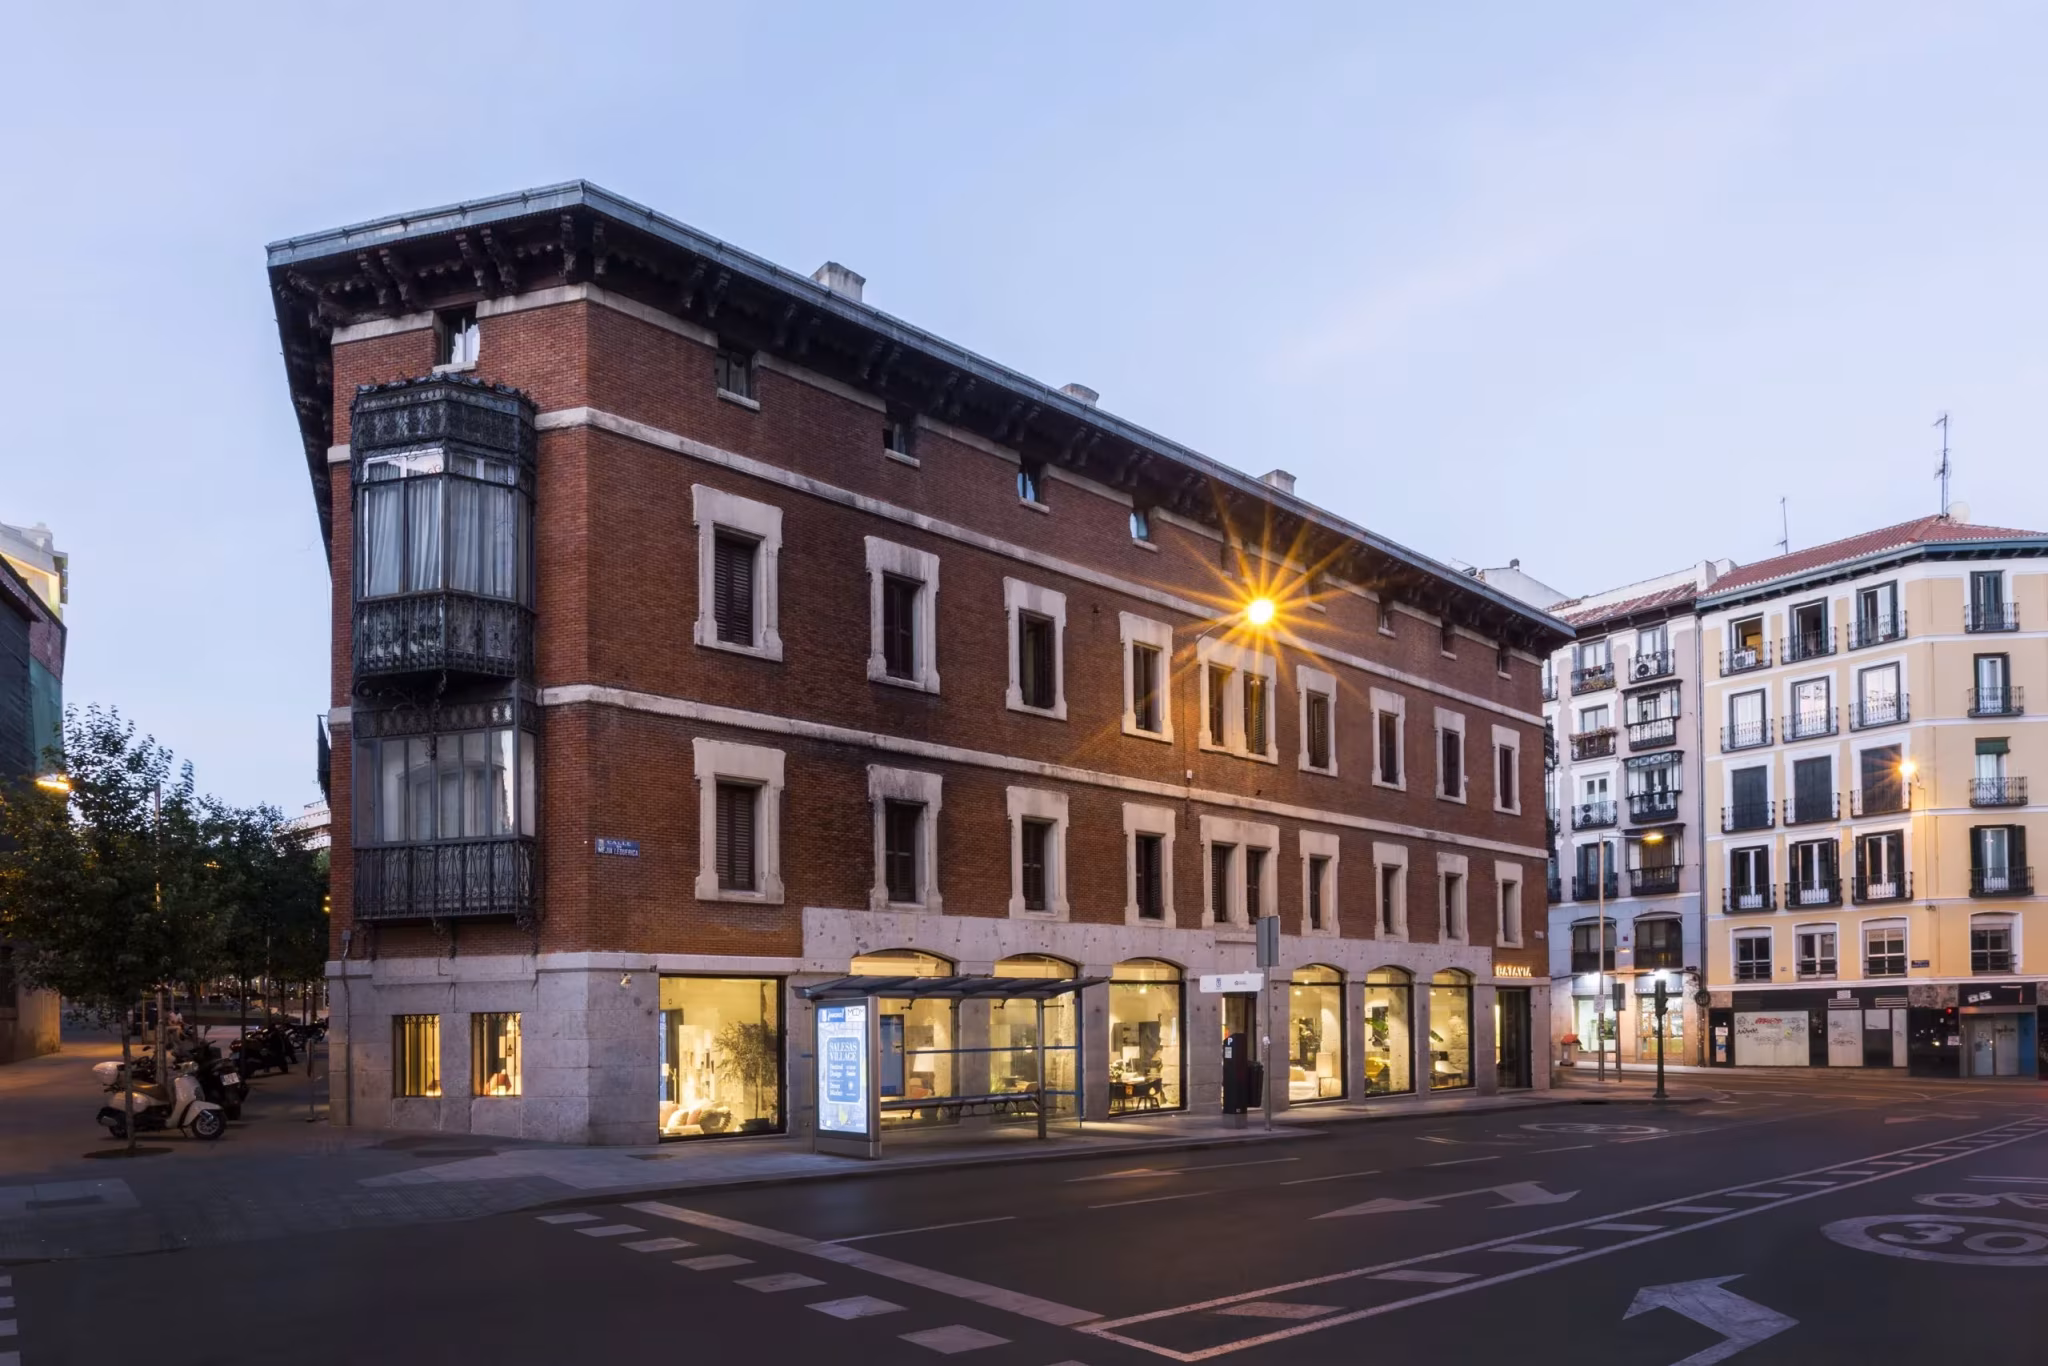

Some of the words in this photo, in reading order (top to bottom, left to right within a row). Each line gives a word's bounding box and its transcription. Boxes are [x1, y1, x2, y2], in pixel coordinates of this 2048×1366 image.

[1496, 965, 1532, 977] BATAVIA
[829, 1041, 858, 1051] SALESAS
[1227, 1037, 1233, 1046] P
[829, 1052, 858, 1062] VILLAGE
[1878, 1222, 2048, 1254] 30
